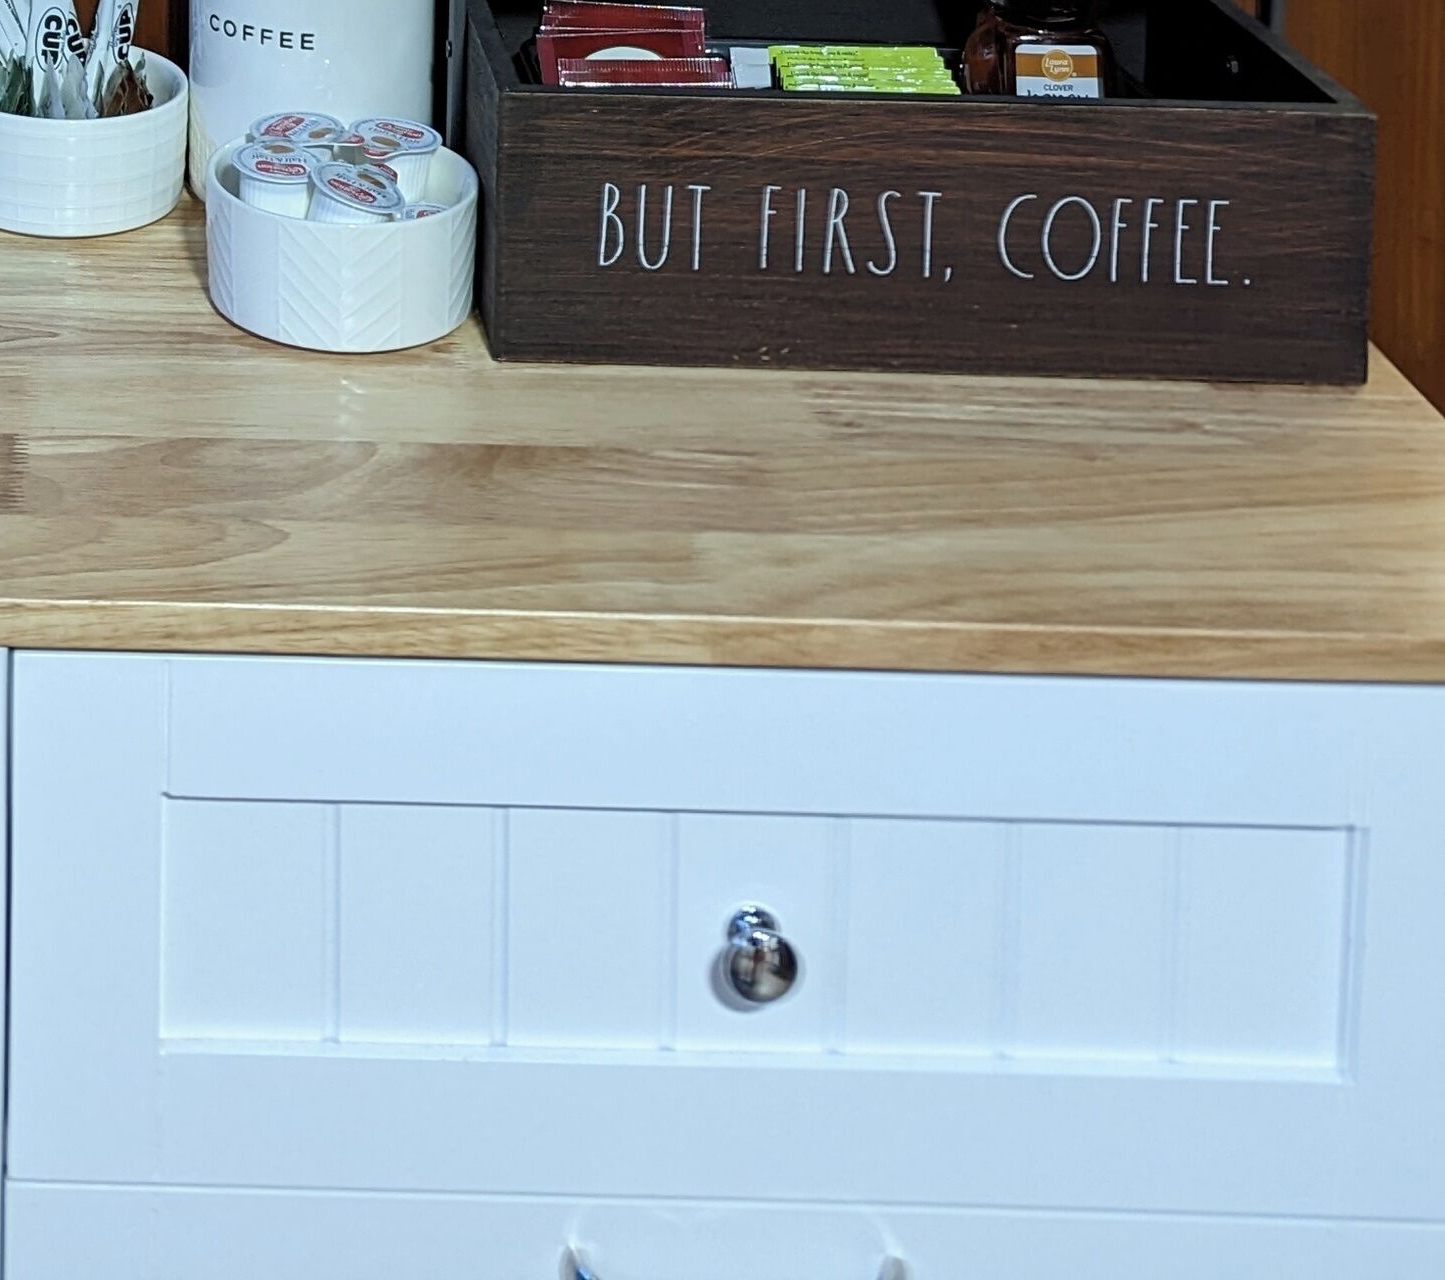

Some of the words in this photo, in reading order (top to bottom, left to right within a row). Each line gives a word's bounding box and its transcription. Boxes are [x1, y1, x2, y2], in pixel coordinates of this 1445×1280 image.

[209, 13, 315, 51] COFFEE
[1045, 58, 1068, 68] Laura
[1049, 65, 1070, 75] Lynn
[1043, 83, 1074, 92] CLOVER
[598, 182, 711, 271] BUT
[759, 186, 953, 280] FIRST,
[998, 194, 1252, 285] COFFEE.
